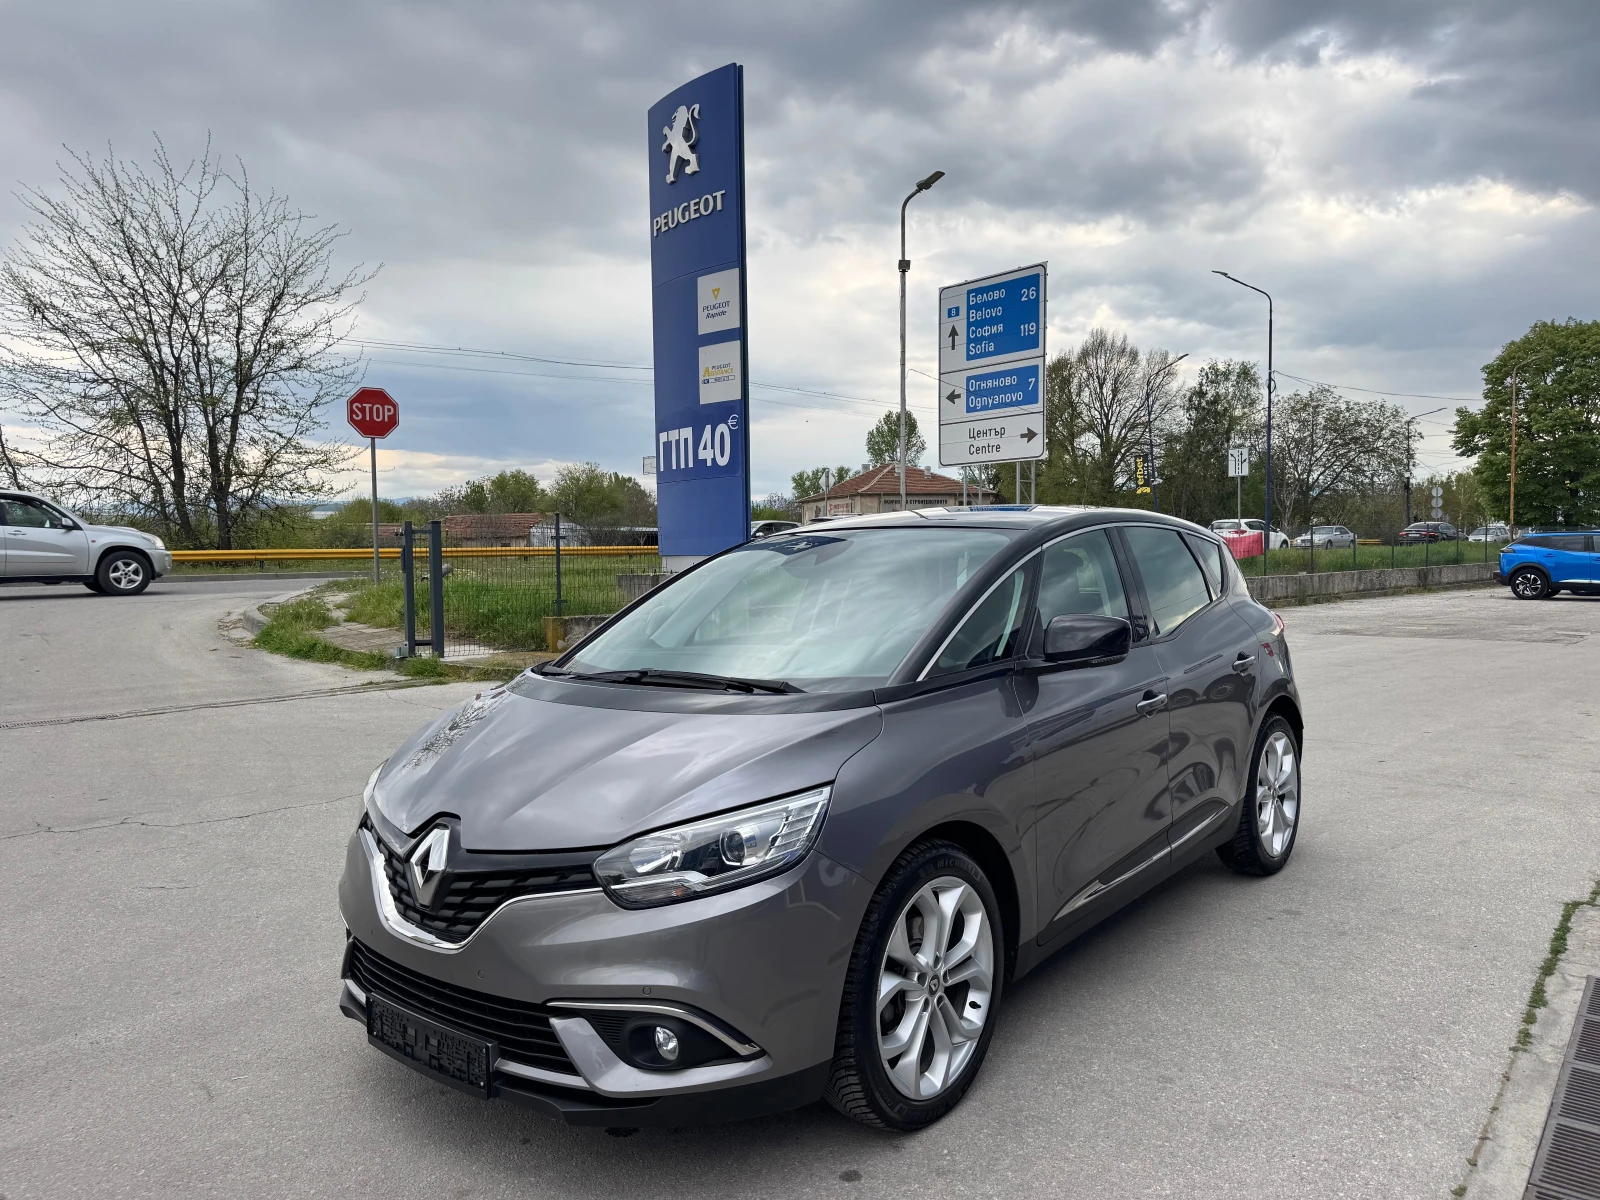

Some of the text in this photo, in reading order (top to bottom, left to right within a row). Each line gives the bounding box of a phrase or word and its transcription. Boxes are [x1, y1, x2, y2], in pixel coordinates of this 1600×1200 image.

[653, 190, 726, 237] PEUGEOT
[969, 286, 1037, 305] Белово 26
[702, 300, 731, 313] PEUGEOT
[705, 310, 728, 320] Rapide
[969, 306, 1003, 322] Belovo
[969, 322, 1037, 339] София 119
[969, 341, 995, 355] Sofia
[969, 375, 1036, 392] Огняново 7
[969, 391, 1024, 410] Ognyanovo
[352, 402, 395, 422] STOP
[968, 426, 1006, 441] Център
[659, 426, 694, 472] ГТП
[968, 442, 1001, 456] Centre
[1135, 456, 1145, 486] efbet
